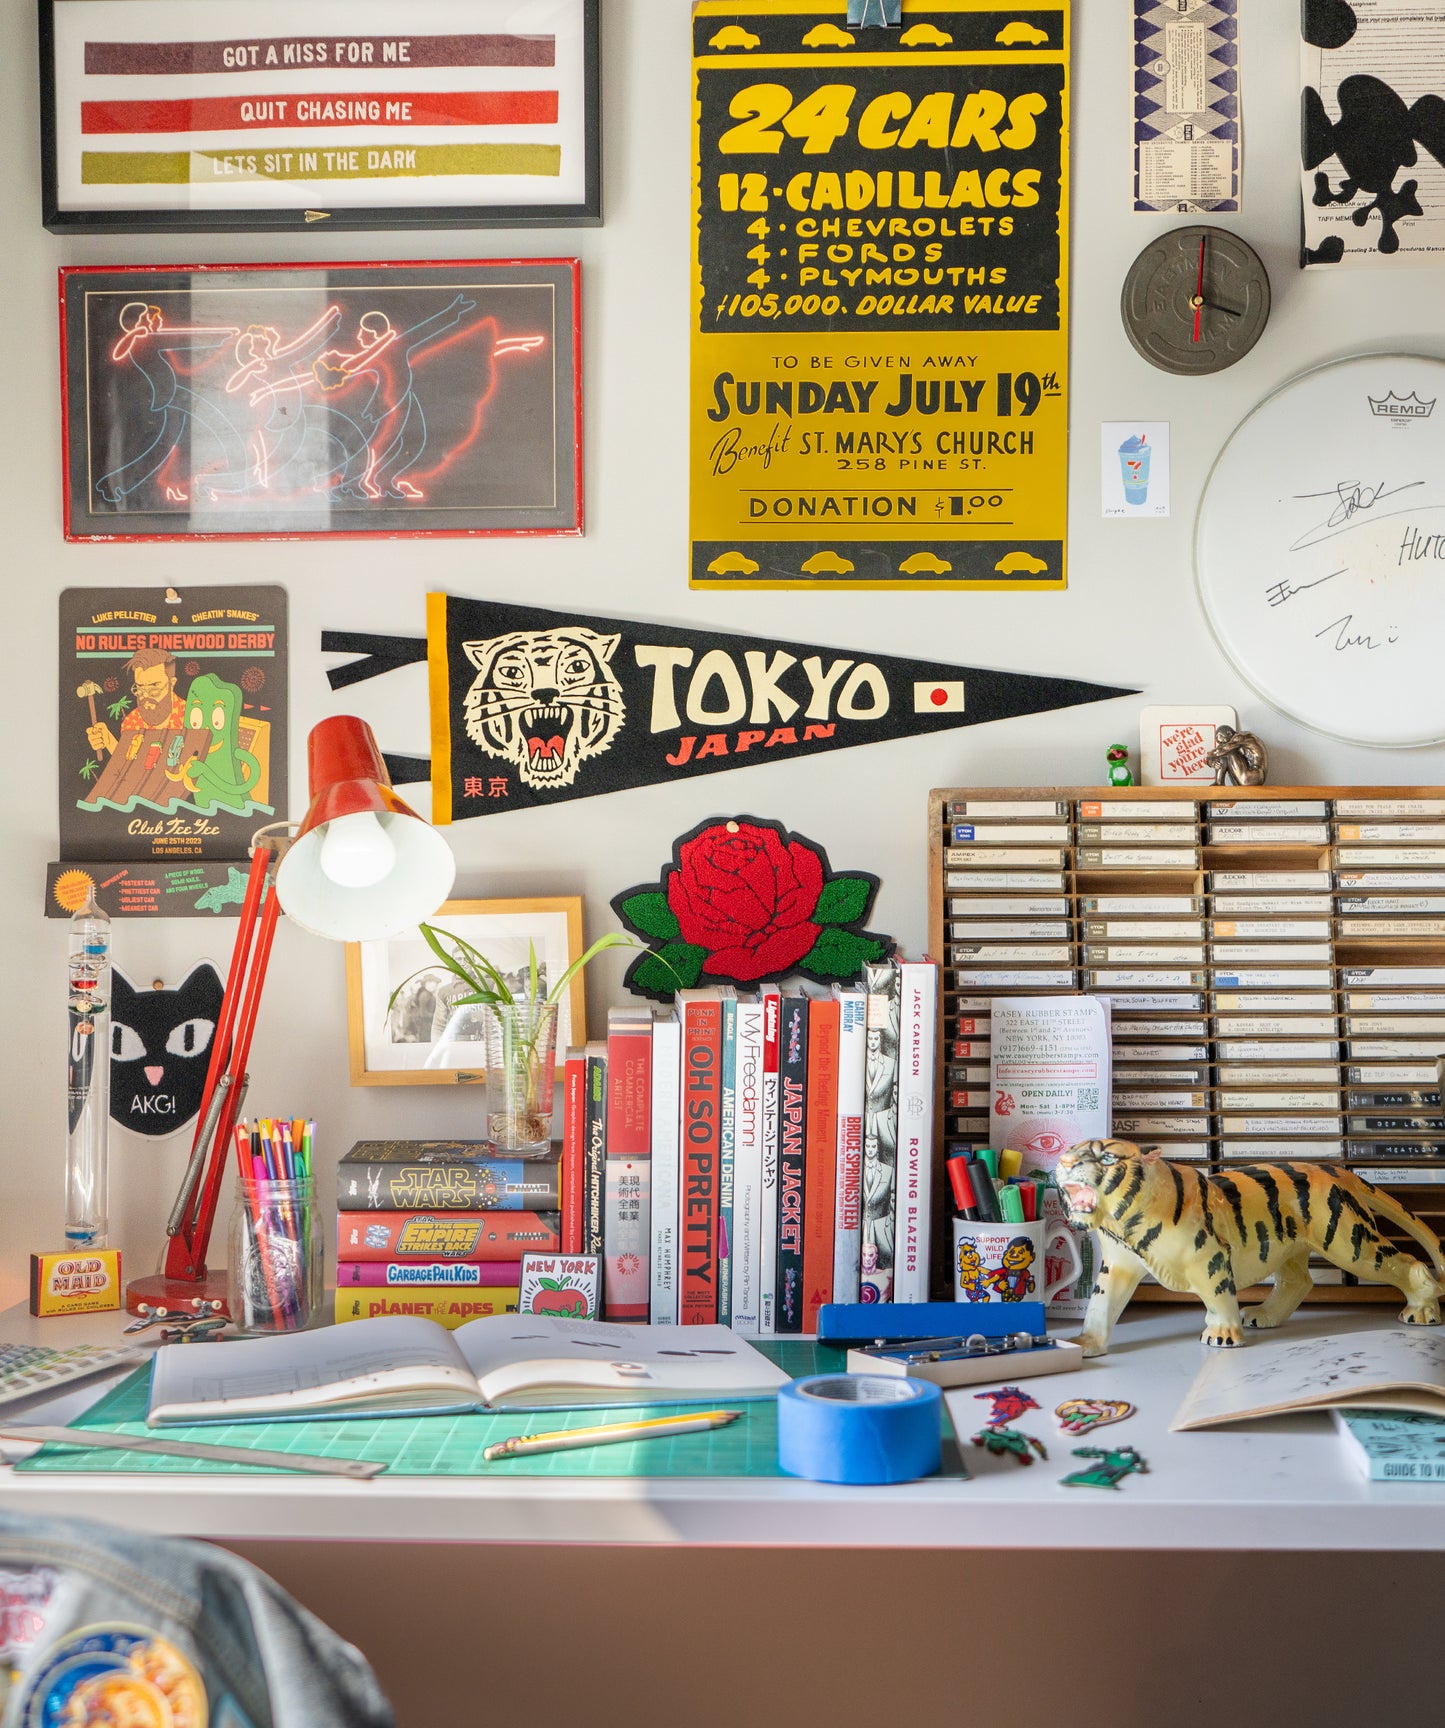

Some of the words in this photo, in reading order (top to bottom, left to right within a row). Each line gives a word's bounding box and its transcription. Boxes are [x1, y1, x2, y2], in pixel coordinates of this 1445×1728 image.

[223, 47, 259, 67] GOT
[265, 45, 279, 64] A
[283, 43, 328, 64] KISS
[335, 42, 373, 63] FOR
[382, 42, 411, 62] ME
[240, 102, 287, 122] QUIT
[296, 101, 380, 121] CHASING
[386, 102, 412, 120] ME
[718, 84, 856, 154] 24
[858, 90, 1047, 152] CARS
[213, 154, 257, 175] LETS
[264, 152, 294, 173] SIT
[298, 152, 318, 172] IN
[324, 152, 360, 171] THE
[367, 149, 416, 170] DARK
[796, 216, 1014, 237] CHEVROLETS
[799, 242, 942, 264] FORDS
[800, 266, 1007, 286] PLYMOUTHS
[856, 294, 953, 314] DOLLAR
[964, 294, 1042, 313] VALUE
[772, 356, 798, 369] TO
[810, 356, 833, 368] BE
[844, 356, 911, 368] GIVEN
[922, 356, 979, 368] AWAY
[708, 372, 880, 422] SUNDAY
[885, 374, 986, 416] JULY
[997, 371, 1062, 416] 19th
[708, 422, 793, 476] Benefit
[799, 431, 828, 454] ST.
[835, 428, 923, 455] MARY'S
[936, 431, 1034, 455] CHURCH
[836, 458, 887, 471] 258
[900, 458, 948, 470] PINE
[959, 458, 987, 470] ST.
[750, 496, 918, 517] DONATION
[92, 611, 114, 624] LUKE
[114, 610, 157, 624] PELLETIER
[172, 614, 178, 624] &
[192, 610, 226, 622] CHEATIN'
[76, 635, 96, 650] NO
[98, 634, 146, 650] RULES
[148, 634, 225, 650] PINEWOOD
[228, 633, 275, 649] DERBY
[636, 644, 890, 734] TOKYO
[666, 724, 836, 767] JAPAN
[1162, 726, 1194, 748] we're
[1176, 732, 1204, 756] glad
[464, 776, 508, 798] 東京
[128, 818, 164, 835] Club
[165, 817, 193, 835] Tee
[844, 1000, 854, 1032] MURRAY
[913, 989, 921, 1021] JACK
[740, 1014, 761, 1044] My
[766, 1000, 777, 1043] Lightning
[819, 1024, 832, 1055] Beyond
[912, 1024, 920, 1077] CARLSON
[636, 1058, 645, 1075] THE
[689, 1046, 714, 1092] OH
[818, 1056, 832, 1072] the
[130, 1094, 176, 1114] AKG!
[614, 1078, 623, 1111] ARTIST
[624, 1060, 634, 1129] COMMERCIAL
[636, 1078, 645, 1132] COMPLETE
[814, 1073, 831, 1106] Fleeting
[592, 1118, 603, 1136] The
[688, 1099, 714, 1144] SO
[721, 1087, 734, 1160] AMERICAN
[783, 1076, 803, 1155] JAPAN
[816, 1109, 830, 1143] Moment
[846, 1116, 862, 1152] BRUCE
[588, 1136, 603, 1174] Original
[908, 1138, 919, 1200] ROWING
[390, 1168, 476, 1189] STAR
[720, 1164, 733, 1208] DENIM
[844, 1153, 860, 1230] SPRINGSTEEN
[390, 1188, 476, 1208] WARS
[591, 1174, 600, 1234] HITCHHIKER
[618, 1176, 629, 1222] 美術全集
[629, 1176, 640, 1222] 現代商業
[744, 1185, 752, 1226] Photography
[782, 1162, 802, 1255] JACKET
[686, 1152, 713, 1284] PRETTY
[400, 1242, 444, 1251] STRIKES
[444, 1242, 472, 1250] BACK
[404, 1226, 477, 1242] EMPIRE
[663, 1228, 672, 1244] MAX
[906, 1207, 918, 1273] BLAZERS
[53, 1274, 107, 1292] MAID
[58, 1260, 102, 1276] OLD
[526, 1260, 556, 1274] NEW
[560, 1260, 596, 1275] YORK
[663, 1249, 671, 1290] HUMPHREY
[370, 1299, 435, 1318] PLANET
[451, 1302, 494, 1316] APES
[1384, 1463, 1416, 1476] GUIDE
[1419, 1464, 1432, 1476] TO
